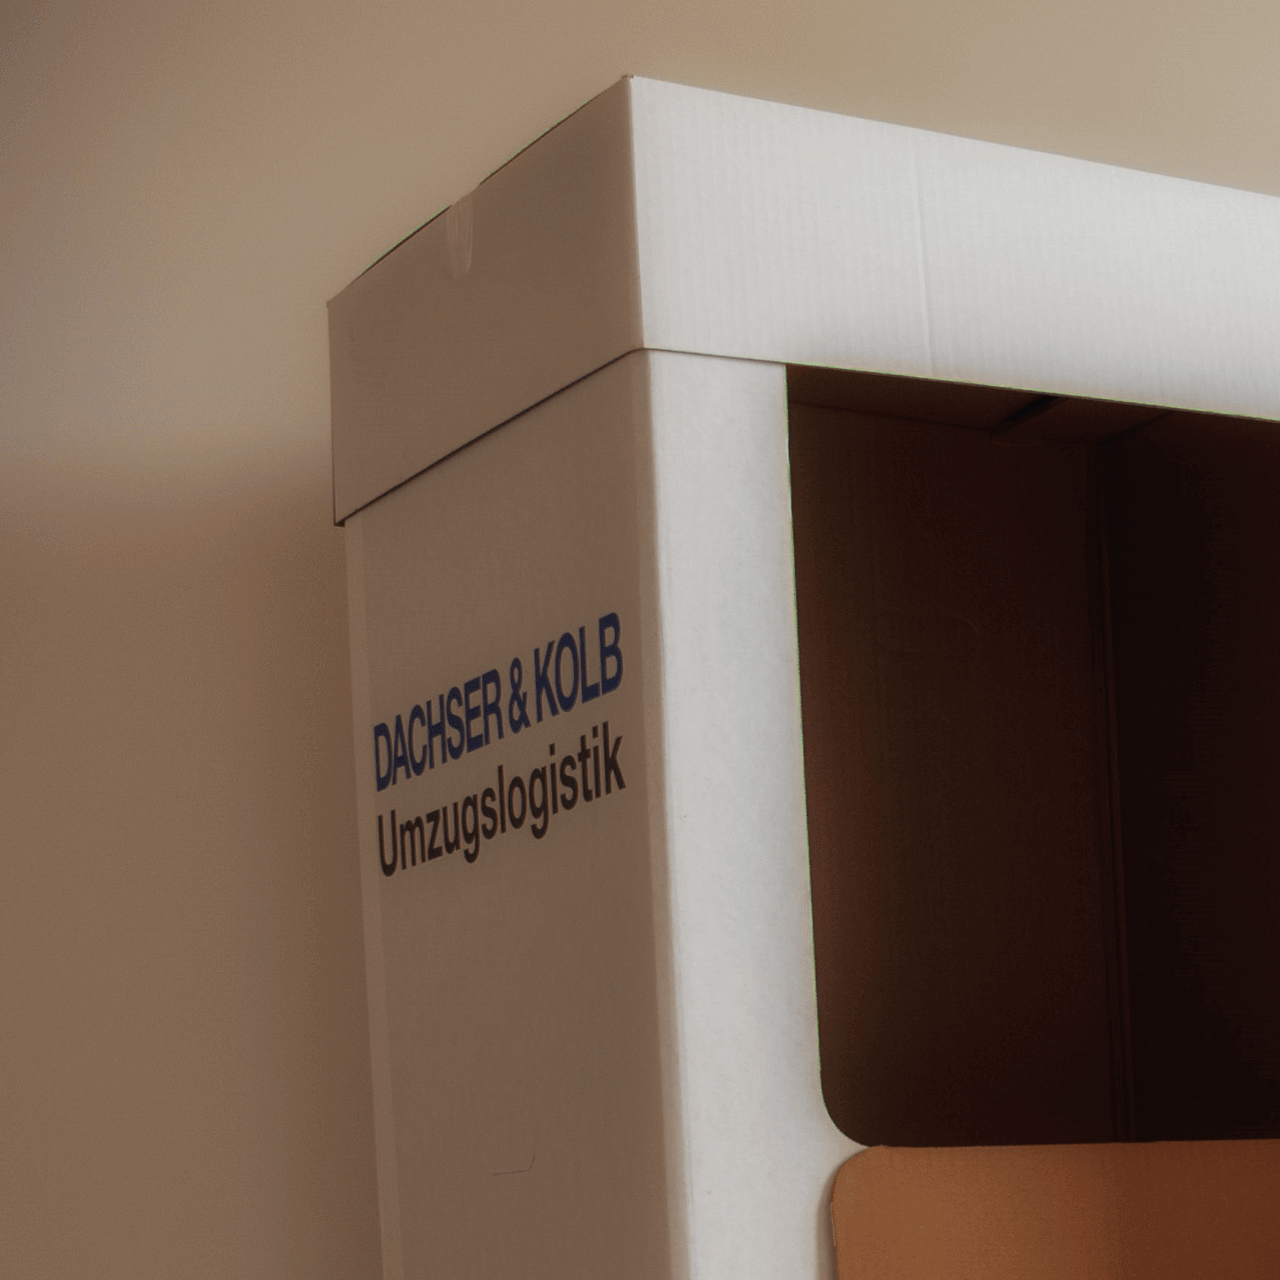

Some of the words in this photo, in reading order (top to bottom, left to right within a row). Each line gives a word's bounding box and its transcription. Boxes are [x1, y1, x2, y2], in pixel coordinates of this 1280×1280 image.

[374, 668, 504, 792] DACHSER
[508, 657, 531, 734] &
[533, 612, 624, 724] KOLB
[377, 721, 627, 877] Umzugslogistik
